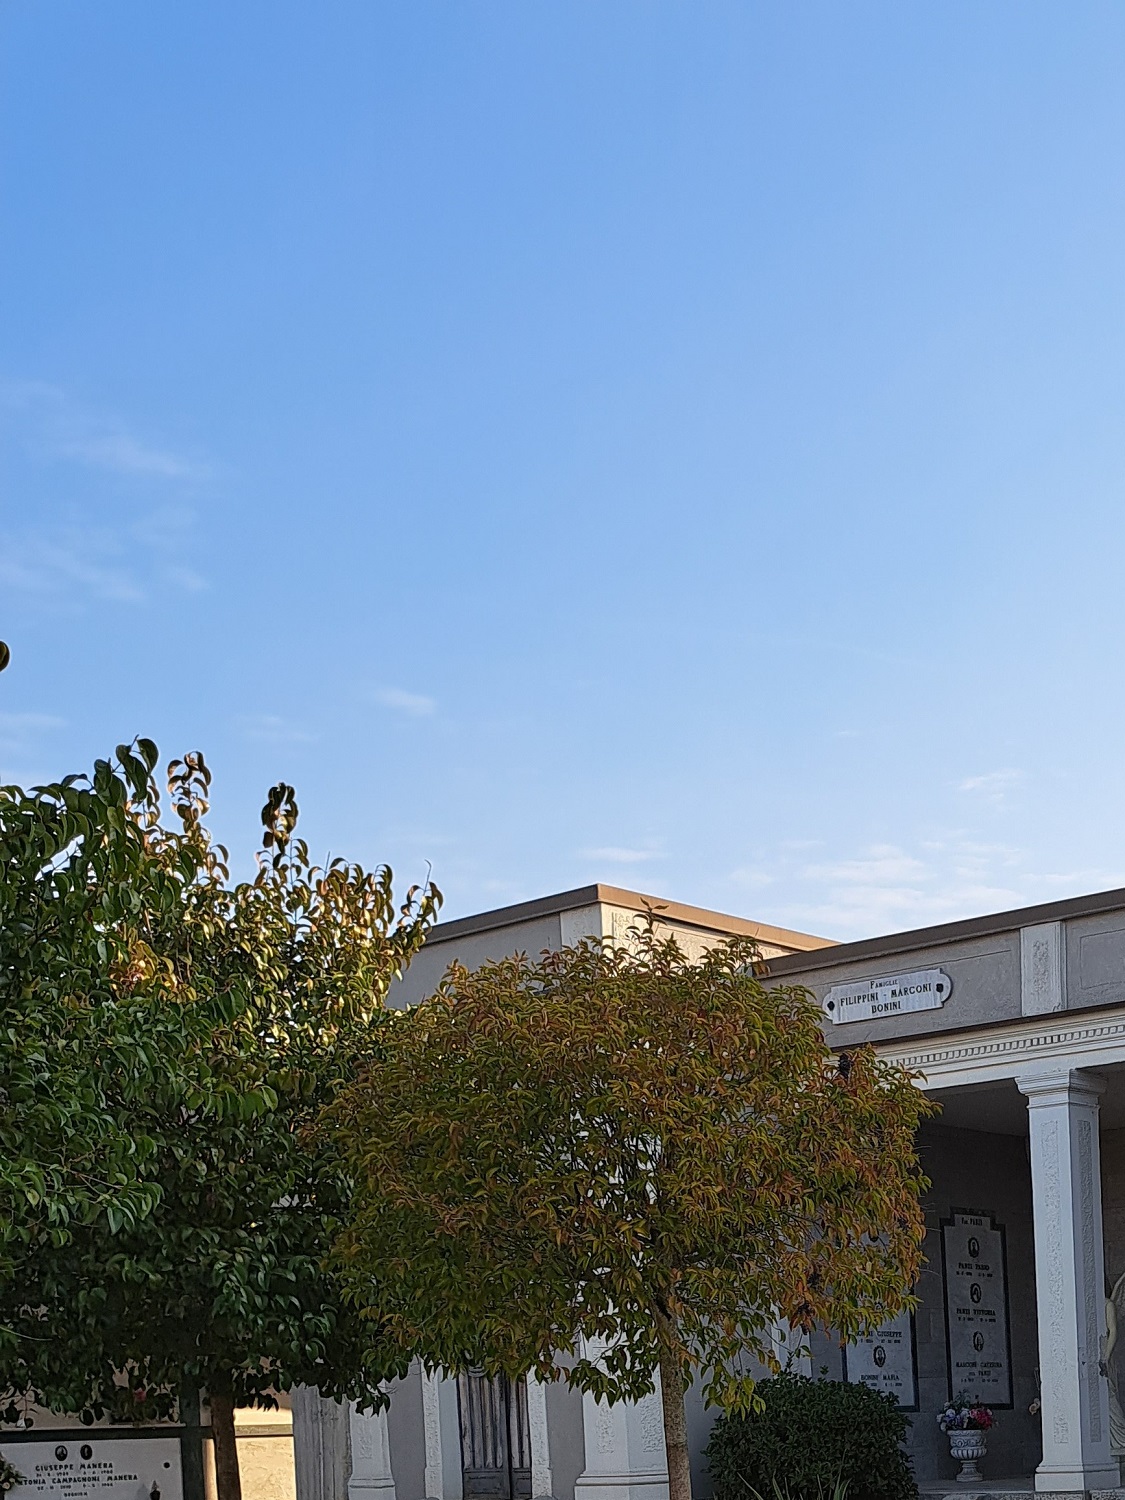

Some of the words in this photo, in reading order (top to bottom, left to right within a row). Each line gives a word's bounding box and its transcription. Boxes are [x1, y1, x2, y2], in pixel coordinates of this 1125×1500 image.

[839, 991, 879, 1007] FILIPPINI
[890, 982, 932, 998] MARCONI
[871, 1000, 901, 1014] BONINI
[35, 1463, 74, 1472] GIUSEPPE
[79, 1462, 113, 1470] MANERA
[52, 1476, 100, 1484] CAMPAGNONI
[107, 1474, 138, 1482] MANERA
